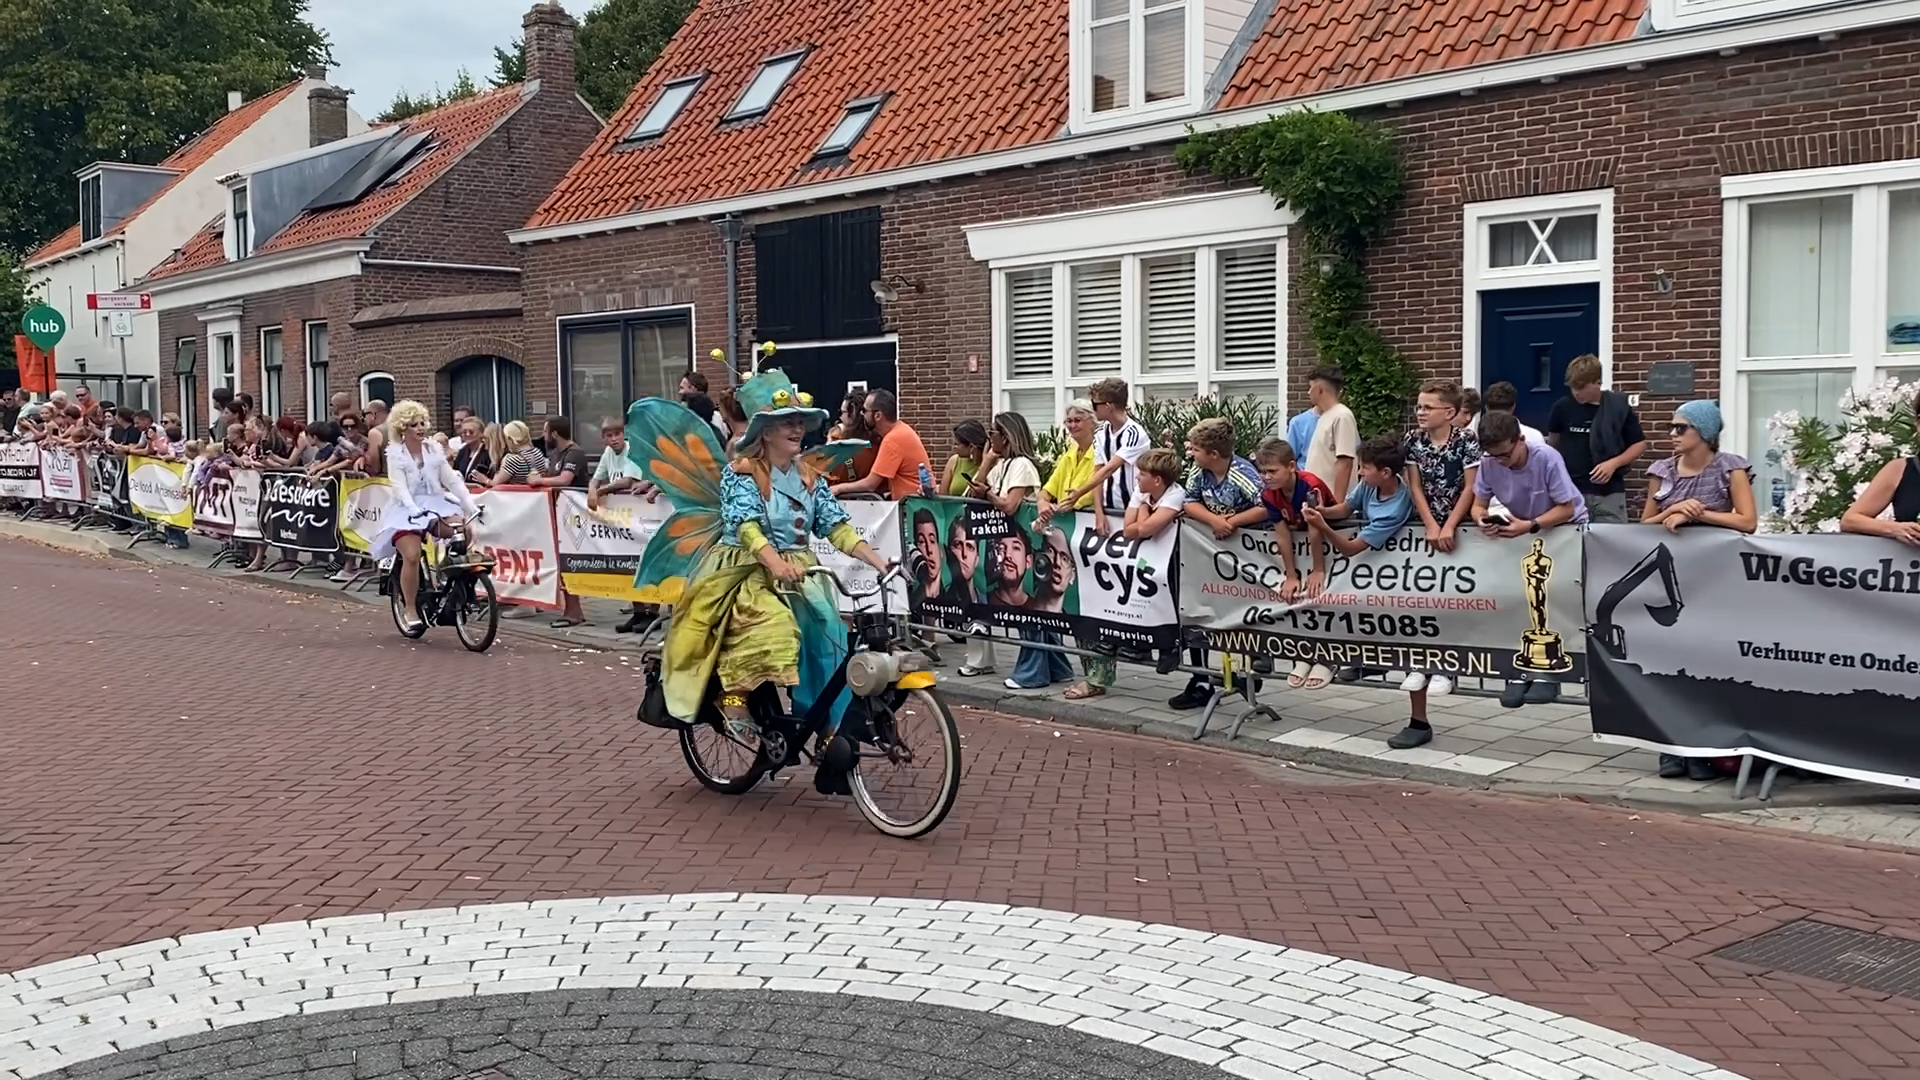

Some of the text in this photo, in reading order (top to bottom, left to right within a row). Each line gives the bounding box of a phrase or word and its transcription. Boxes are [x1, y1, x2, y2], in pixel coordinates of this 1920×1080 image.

[30, 319, 59, 332] hub
[970, 510, 1006, 521] beelden
[590, 524, 635, 541] SERVICE
[971, 522, 1009, 536] raken!
[1079, 526, 1153, 568] per
[1326, 556, 1477, 594] Peeters
[1201, 583, 1266, 601] ALLROUND
[1366, 594, 1386, 607] EN
[1389, 595, 1498, 611] TEGELWERKEN
[922, 602, 963, 616] fotografie
[993, 611, 1071, 629] videoproducties
[1242, 605, 1441, 638] 06-13715085
[1099, 627, 1154, 644] vormgeving
[1207, 631, 1501, 676] WWW.OSCARPEETERS.NL
[1737, 640, 1920, 675] Verhuur en Onde
